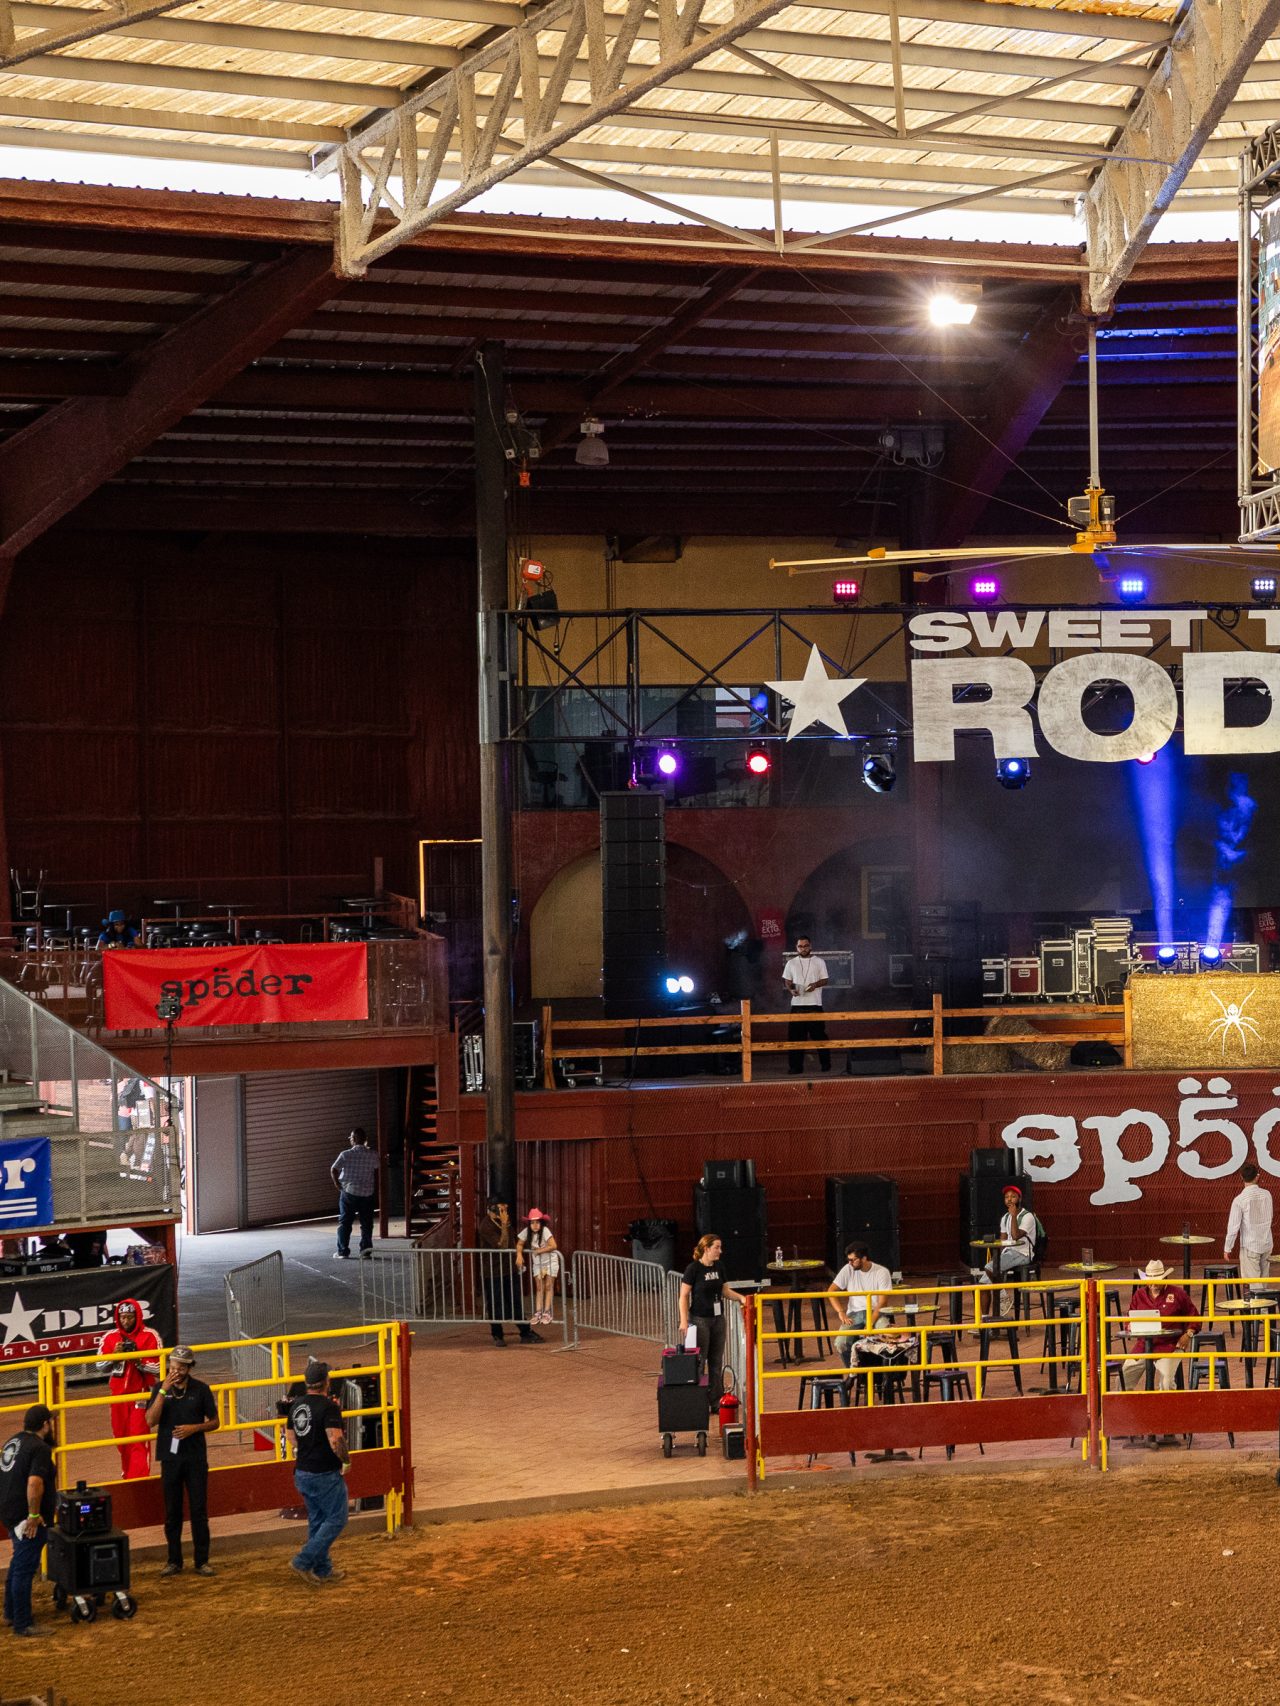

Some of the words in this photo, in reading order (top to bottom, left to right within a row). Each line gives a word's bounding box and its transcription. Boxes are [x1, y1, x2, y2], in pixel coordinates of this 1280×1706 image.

[908, 610, 1208, 652] SWEET
[0, 1157, 36, 1190] r
[4, 1337, 101, 1356] RLDWID
